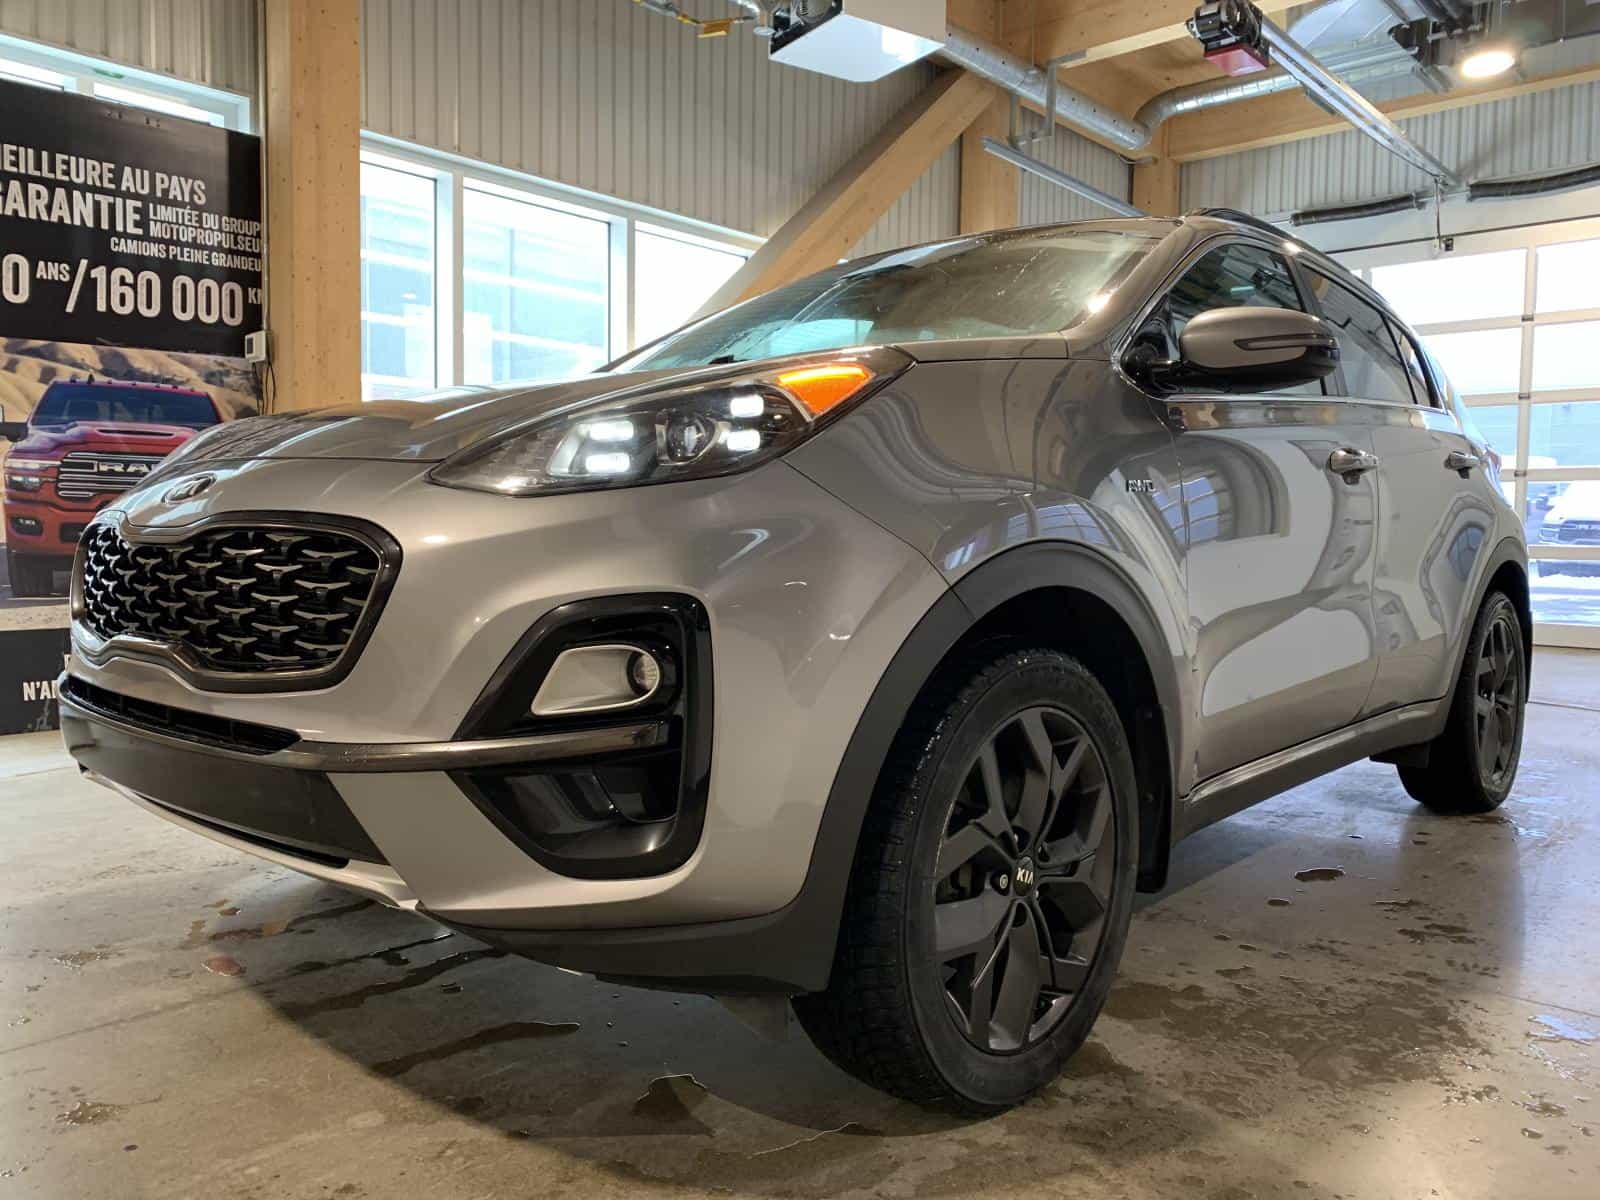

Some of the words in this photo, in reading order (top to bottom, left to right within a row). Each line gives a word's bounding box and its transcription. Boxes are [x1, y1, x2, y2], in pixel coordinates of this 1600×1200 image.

[0, 143, 116, 190] EILLEURE
[121, 166, 150, 195] AU
[155, 172, 207, 205] PAYS
[0, 179, 144, 236] ARANTIE
[149, 203, 199, 227] LIMITÉE
[202, 212, 219, 230] DU
[221, 216, 261, 237] GROUP
[110, 236, 167, 259] CAMIONS
[168, 245, 210, 265] PLEINE
[211, 251, 262, 272] GRANDEU
[149, 220, 262, 253] MOTOPROPULSEU
[36, 261, 71, 282] ANS
[172, 275, 243, 327] 000
[1016, 867, 1034, 886] KIA
